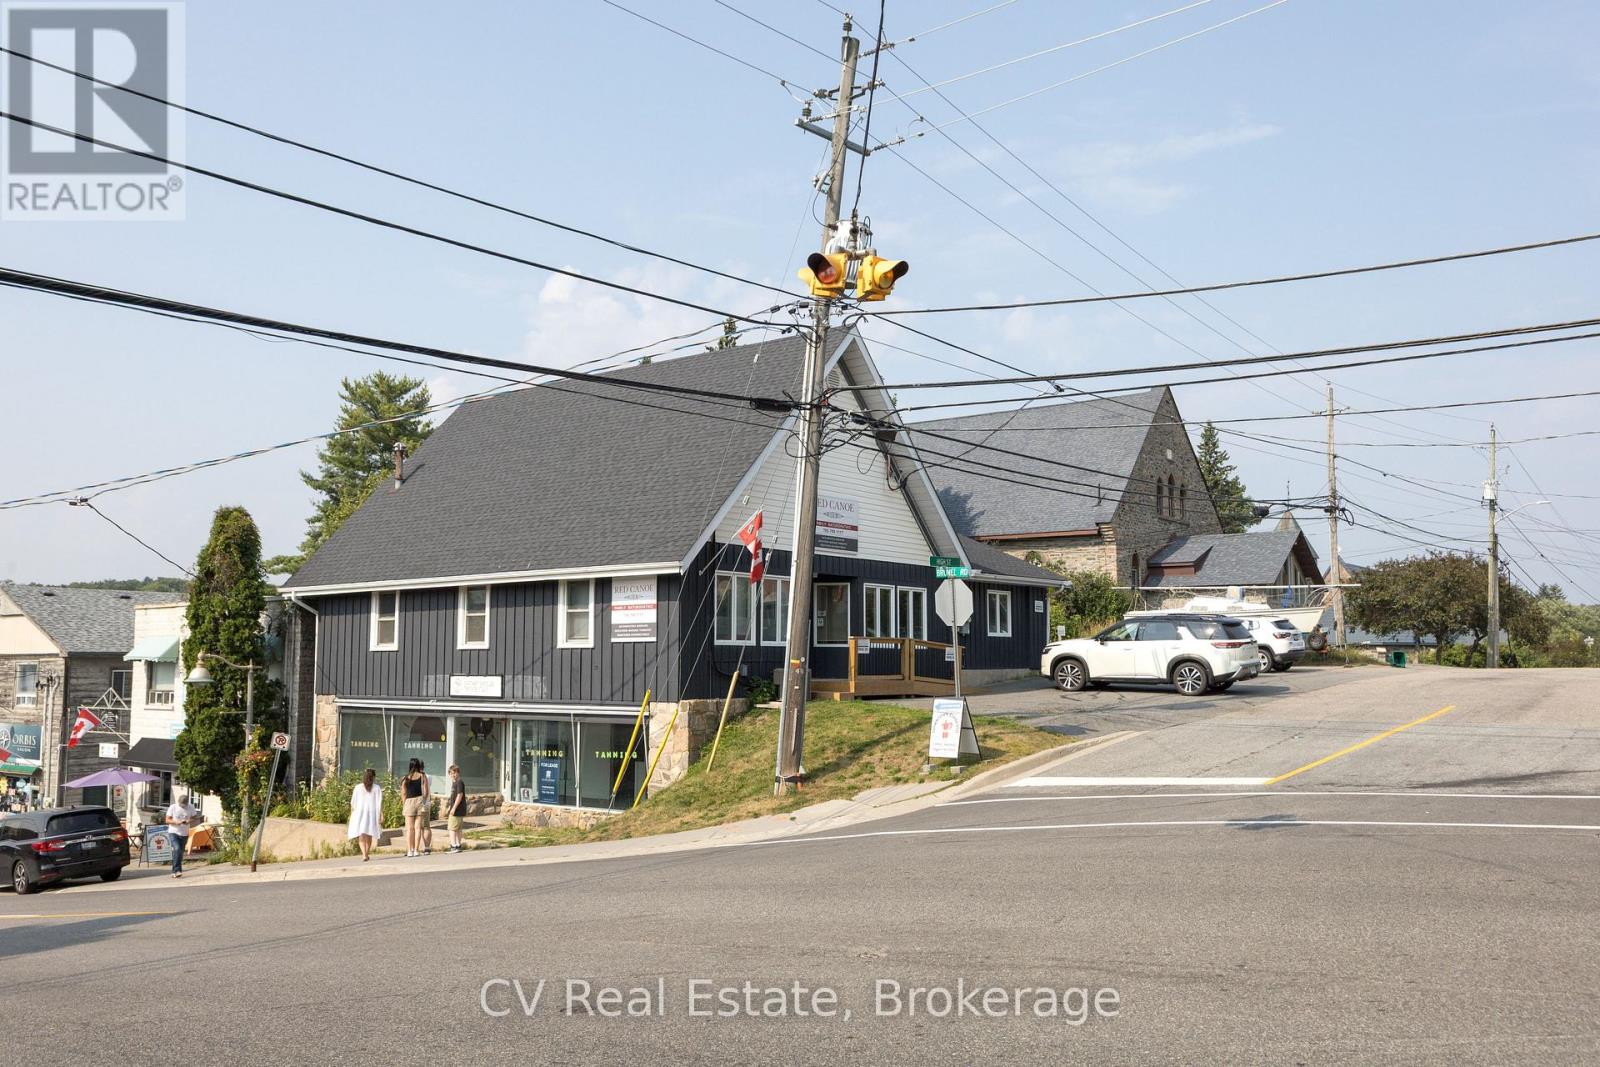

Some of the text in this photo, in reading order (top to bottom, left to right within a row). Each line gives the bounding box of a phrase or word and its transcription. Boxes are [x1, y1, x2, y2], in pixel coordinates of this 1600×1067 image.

[830, 500, 854, 512] CANOE
[960, 568, 968, 576] RD
[614, 584, 654, 594] RED CANOE
[12, 734, 36, 746] ORBIS
[526, 749, 564, 758] TANNING
[595, 751, 638, 759] TANNIG
